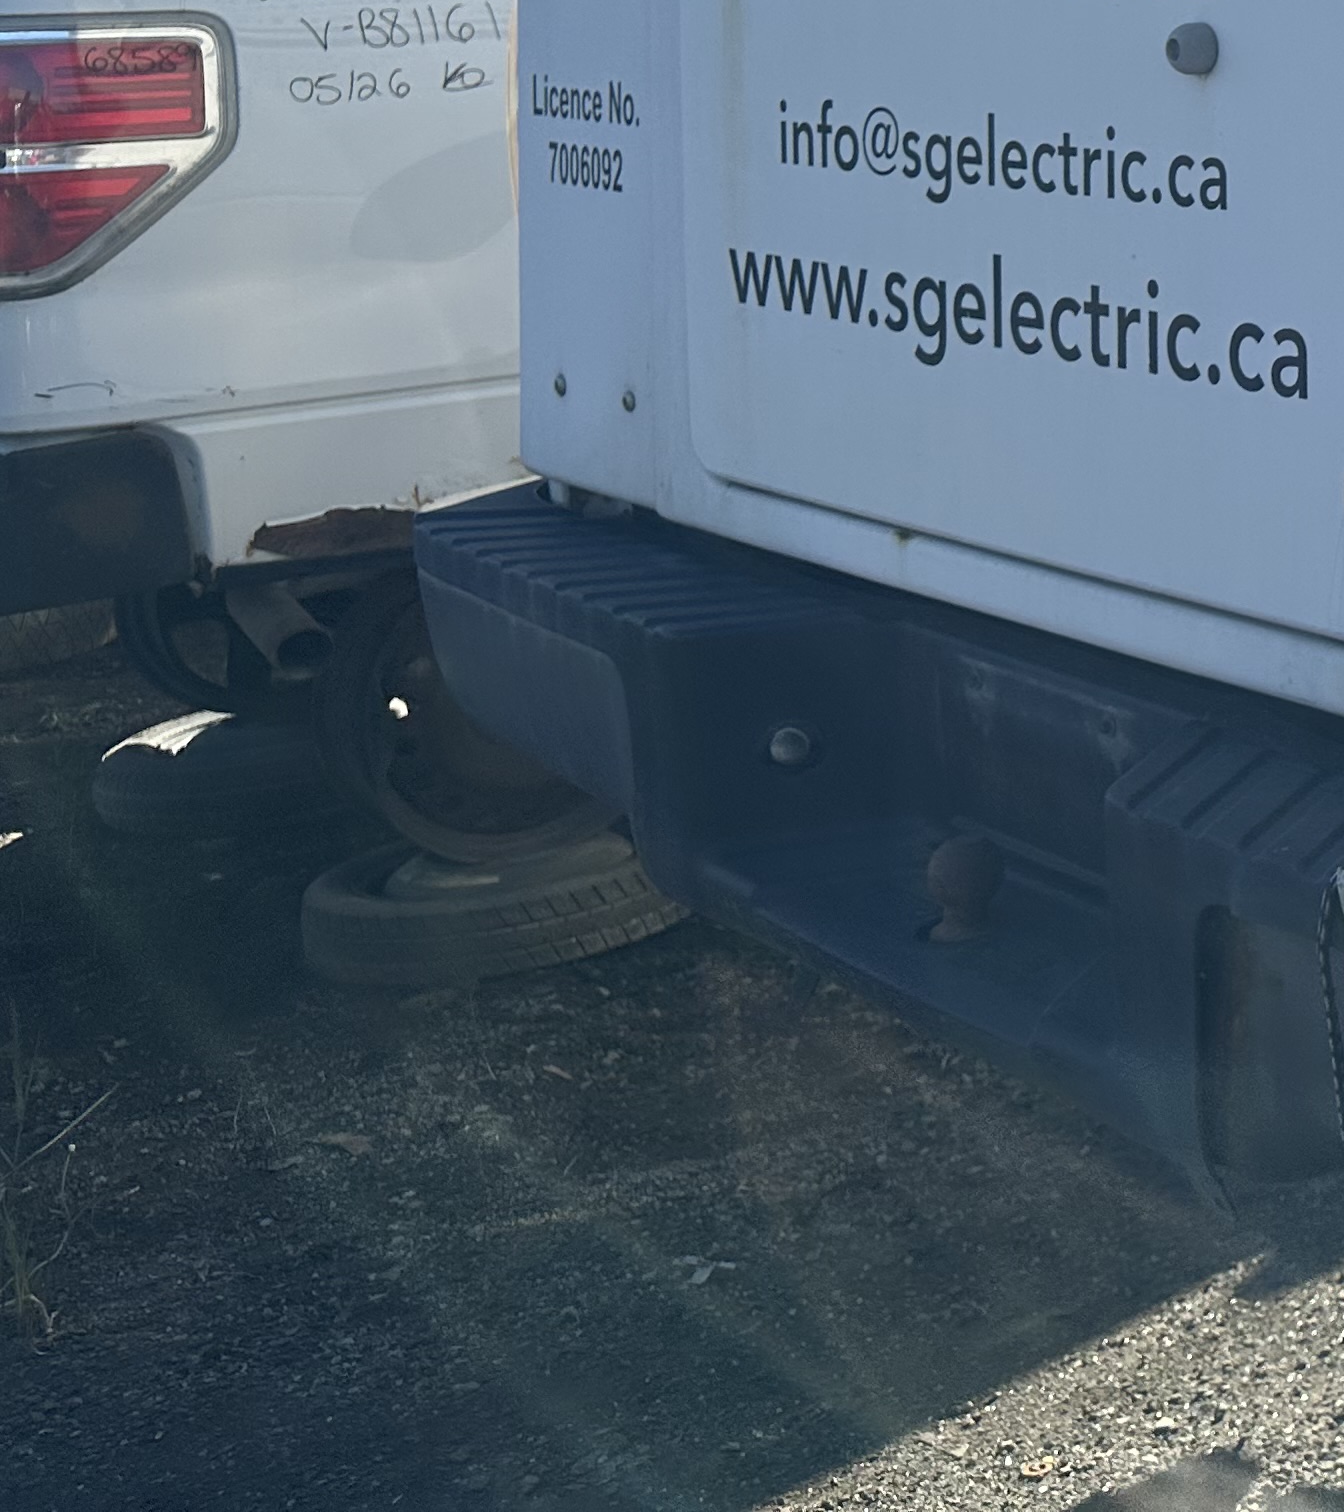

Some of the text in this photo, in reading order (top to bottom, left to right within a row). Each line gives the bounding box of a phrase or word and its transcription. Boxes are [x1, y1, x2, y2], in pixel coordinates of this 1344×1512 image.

[532, 73, 640, 127] Licence No.
[549, 141, 623, 193] 7006092
[779, 99, 1228, 210] info@sgelectric.ca
[729, 248, 1309, 400] www.sgelectric.ca
